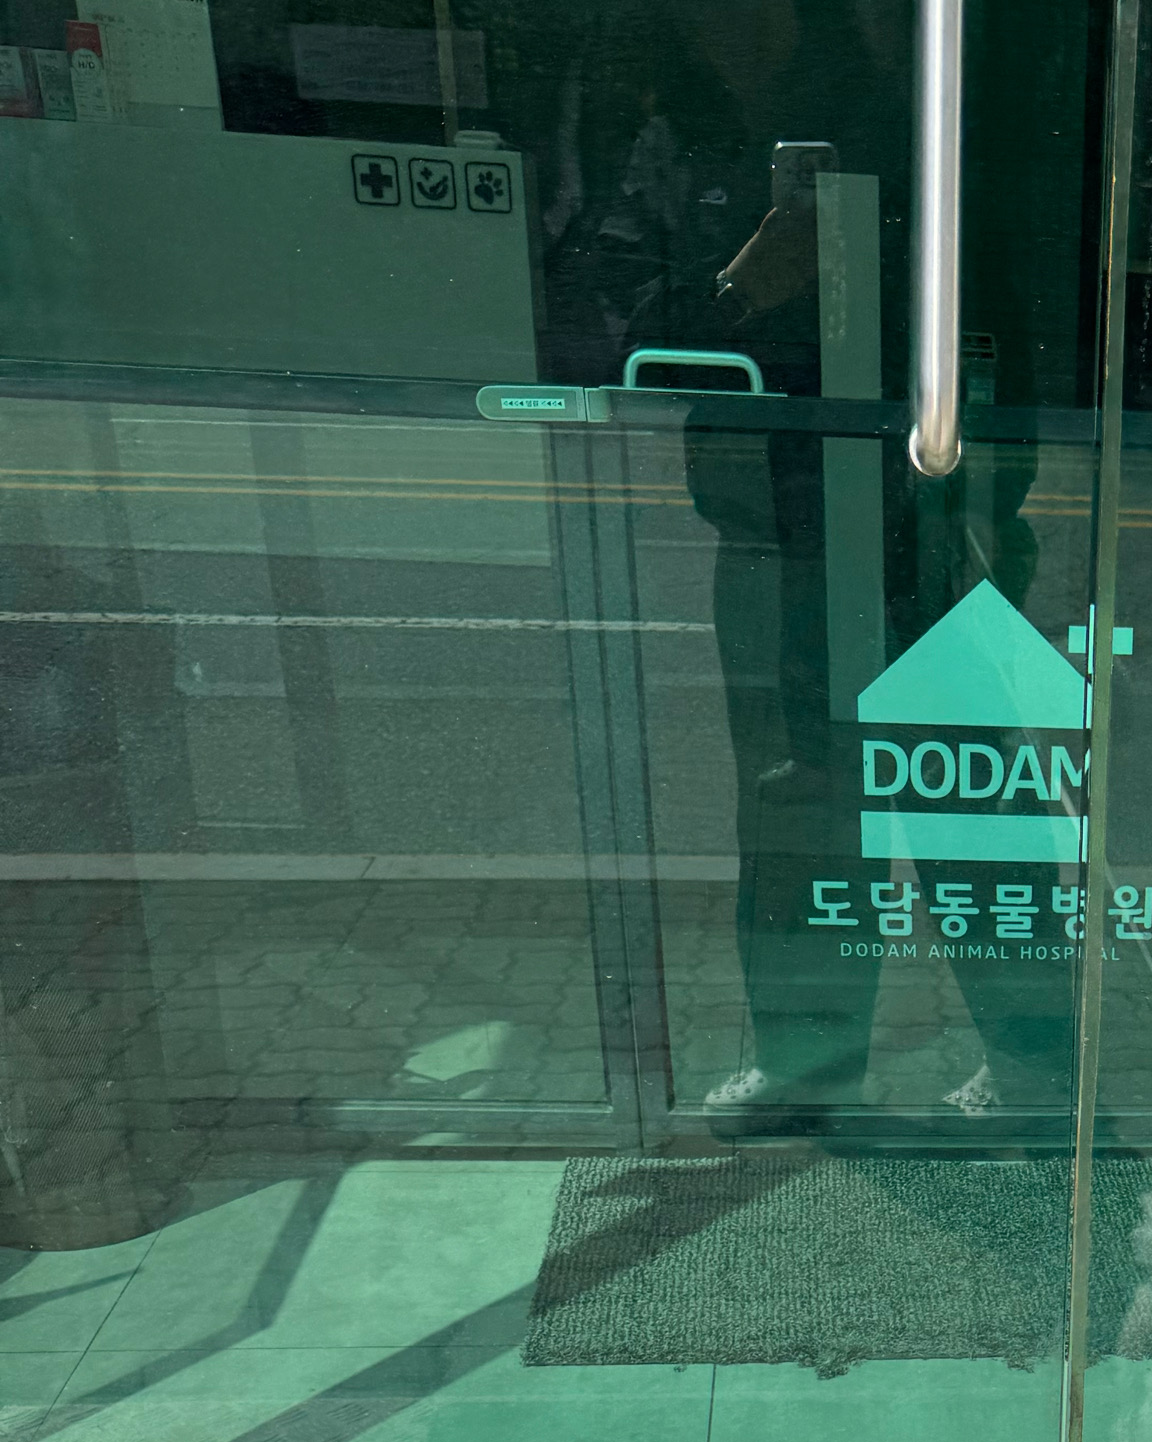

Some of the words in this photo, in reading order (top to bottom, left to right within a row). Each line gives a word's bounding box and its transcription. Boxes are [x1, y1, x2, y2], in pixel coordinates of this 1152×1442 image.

[862, 740, 1091, 801] DODAM
[840, 942, 918, 958] DODAM
[928, 945, 1008, 960] ANIMAL
[1020, 946, 1120, 962] HOSPIAL
